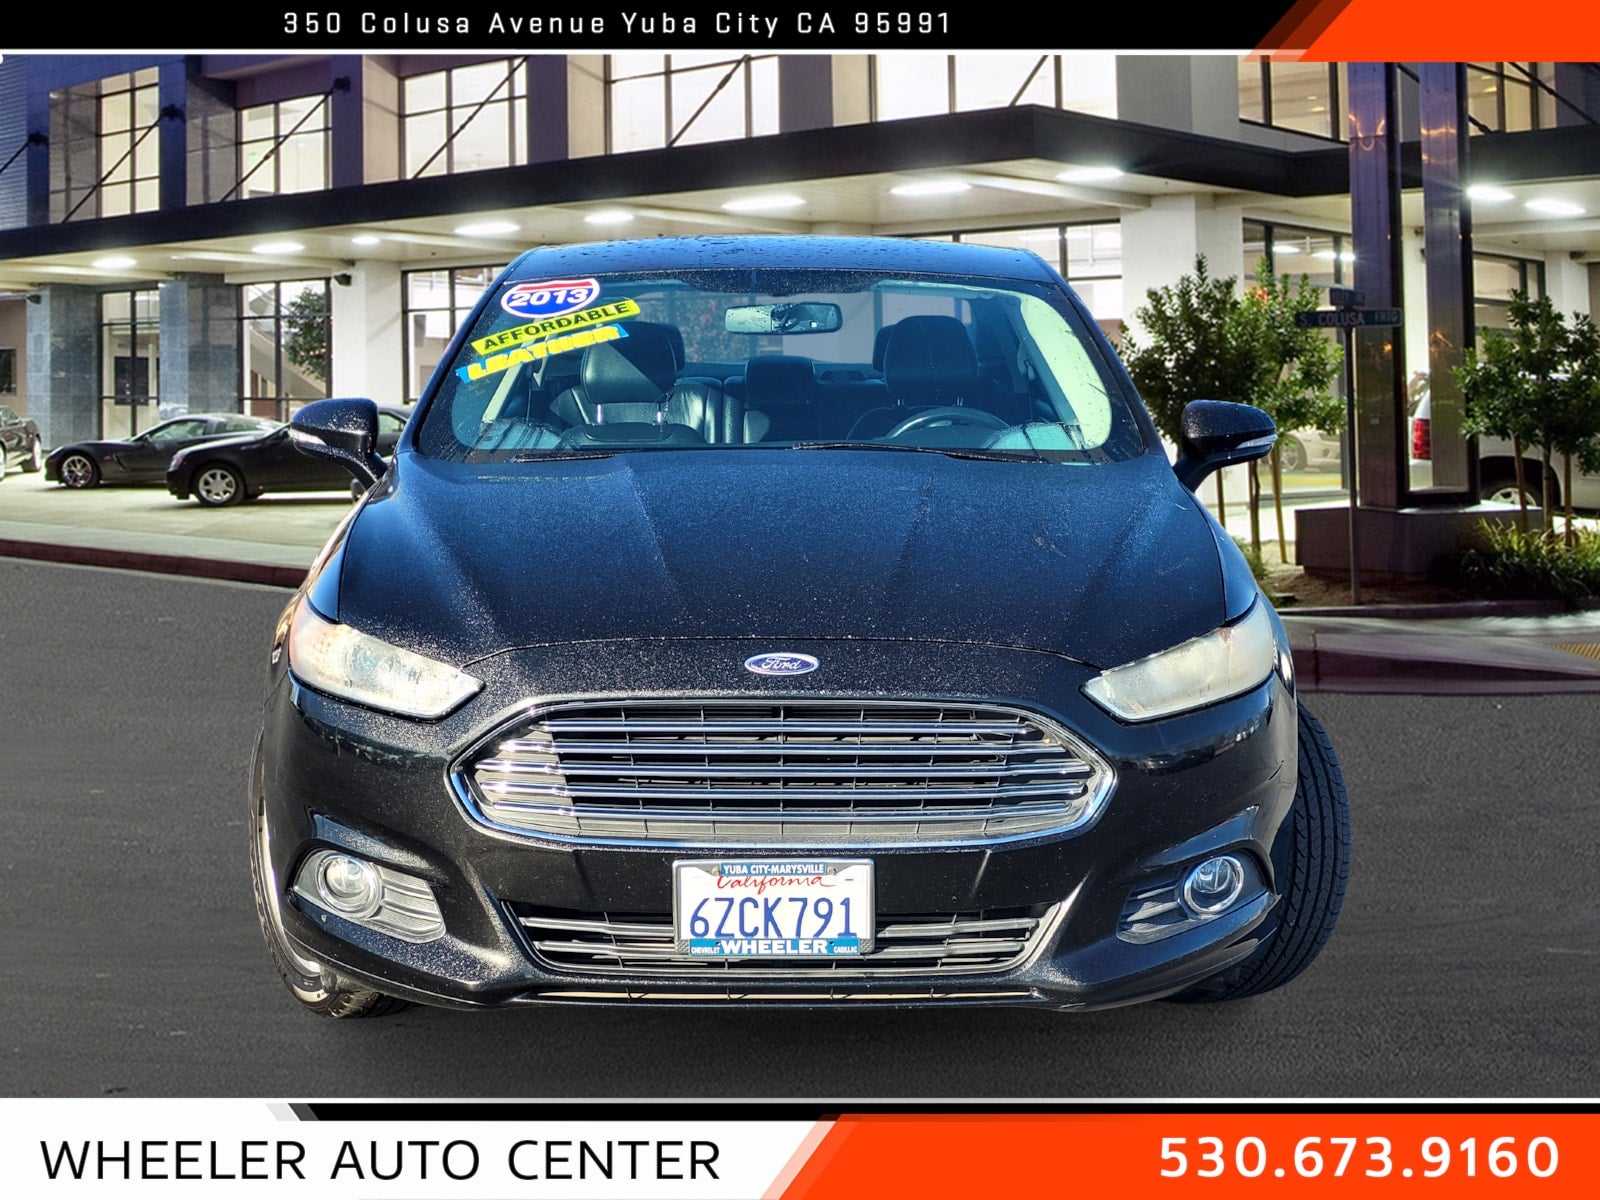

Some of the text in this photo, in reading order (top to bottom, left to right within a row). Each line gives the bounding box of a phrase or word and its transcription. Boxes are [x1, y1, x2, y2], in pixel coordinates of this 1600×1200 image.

[508, 288, 589, 307] 2013
[484, 302, 631, 350] AFFORDABLE
[1318, 311, 1366, 326] COLUSA
[761, 656, 802, 669] Ford
[723, 863, 825, 875] YUBA CITY-MARYSVILLE
[717, 874, 837, 895] California
[689, 896, 858, 939] 6ZCK791
[691, 939, 858, 955] CHEVROLET WHEELER CADILLAC
